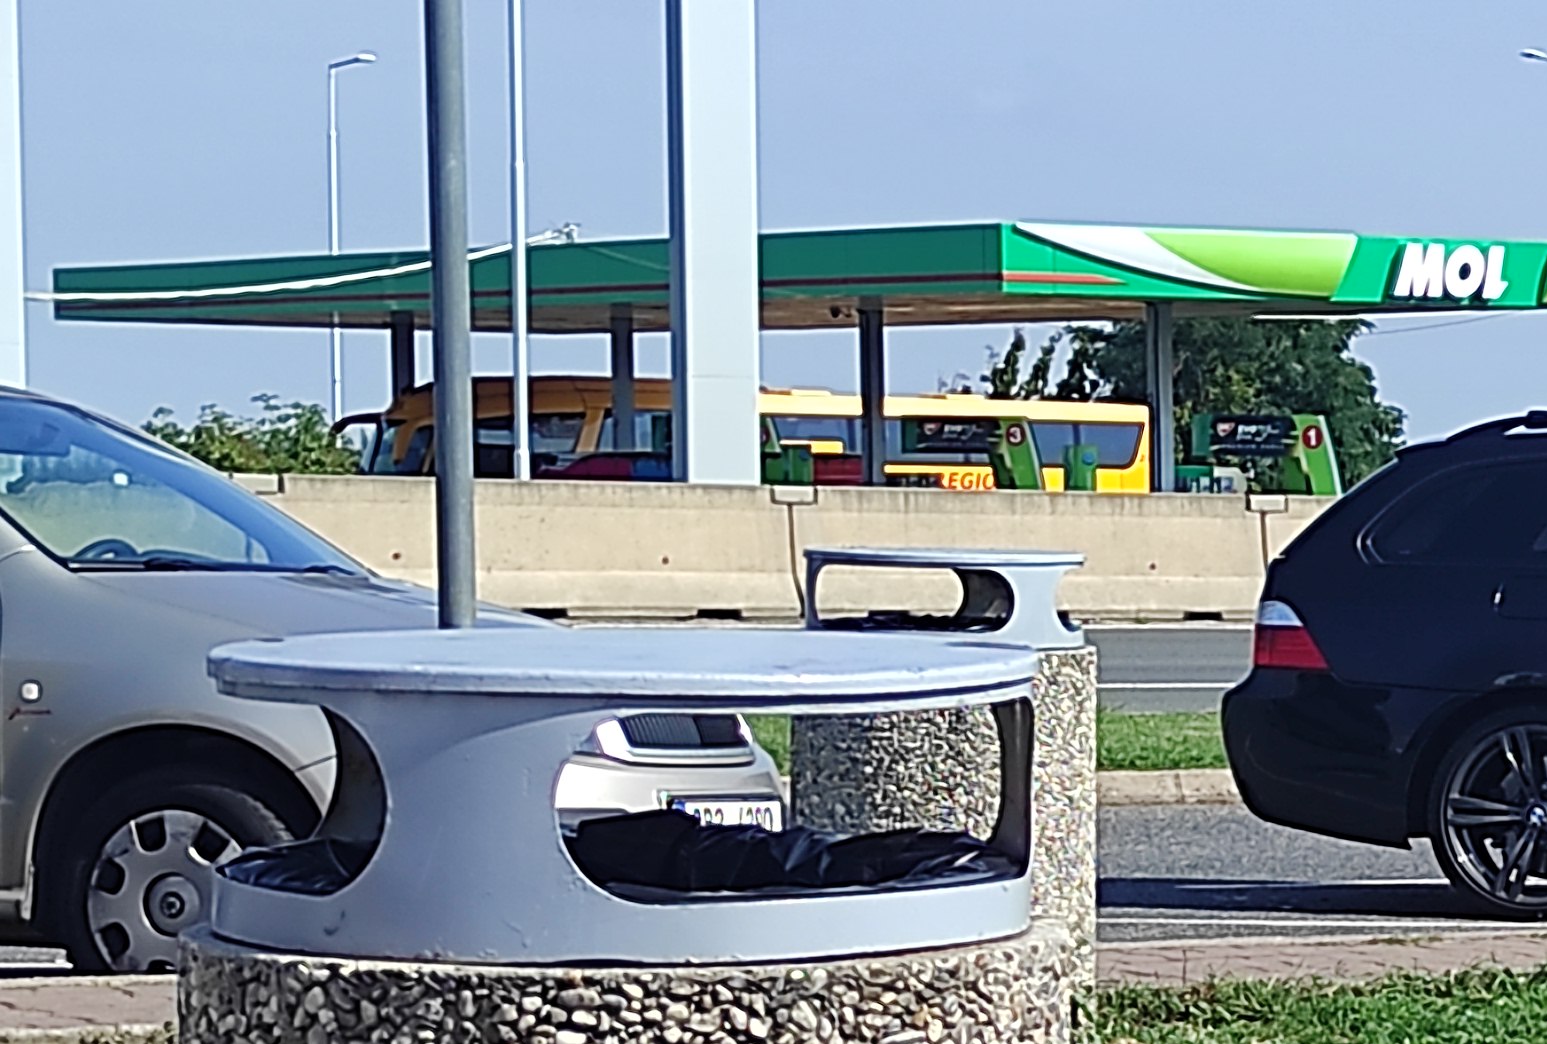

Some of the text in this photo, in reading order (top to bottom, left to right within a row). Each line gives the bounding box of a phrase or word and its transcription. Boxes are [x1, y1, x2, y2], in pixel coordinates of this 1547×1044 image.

[1393, 242, 1509, 300] MOL
[1008, 427, 1022, 443] 3
[1306, 428, 1317, 446] 1
